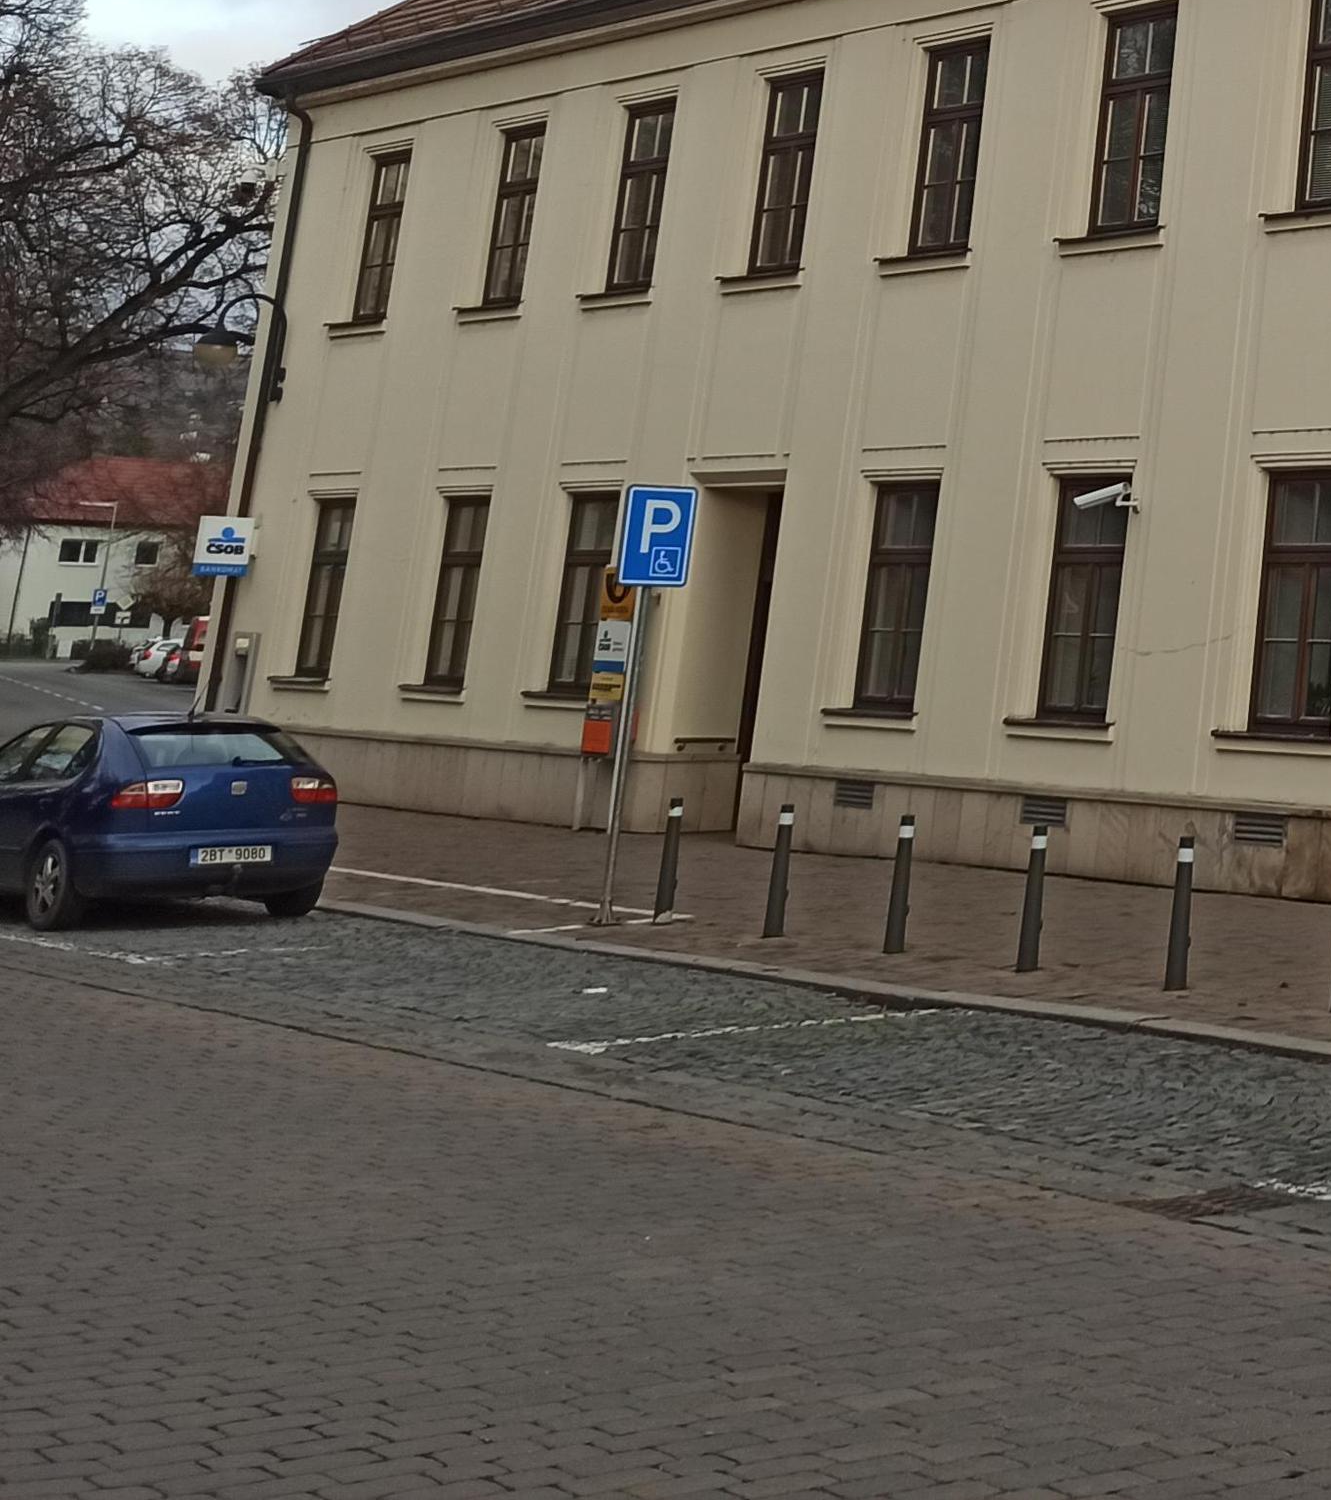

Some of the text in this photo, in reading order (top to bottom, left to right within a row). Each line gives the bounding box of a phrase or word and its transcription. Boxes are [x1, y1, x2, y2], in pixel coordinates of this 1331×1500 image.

[640, 499, 681, 553] P
[206, 542, 244, 555] ČSOB
[95, 590, 105, 601] P
[201, 847, 266, 862] 2BT 9080
